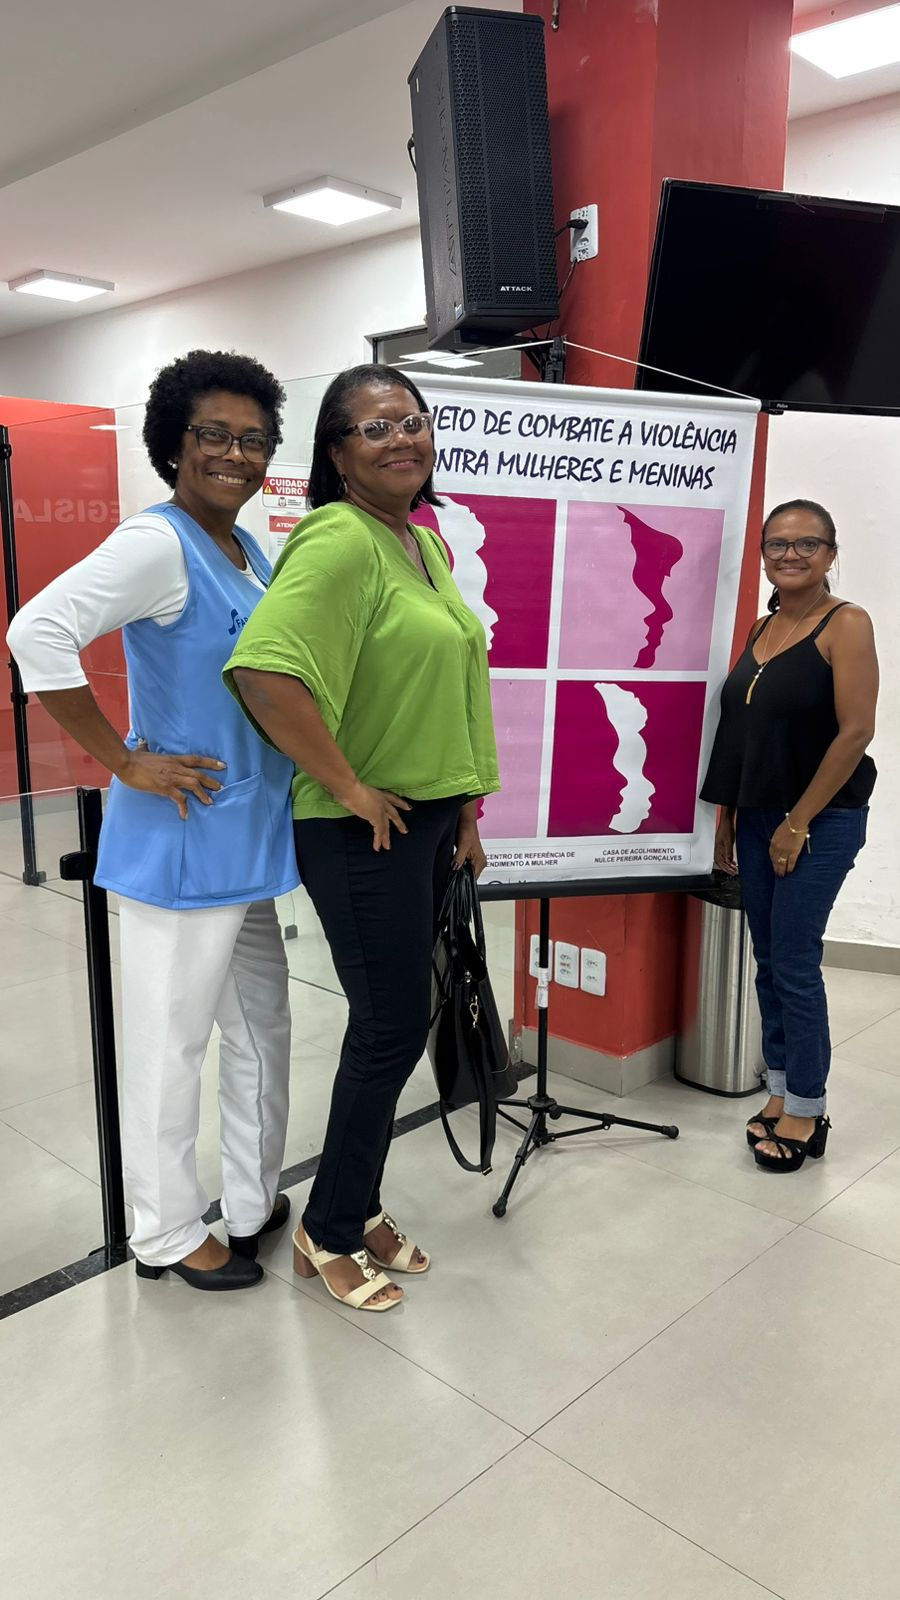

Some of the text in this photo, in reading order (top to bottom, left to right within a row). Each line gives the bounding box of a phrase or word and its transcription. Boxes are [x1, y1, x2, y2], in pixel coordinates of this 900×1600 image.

[483, 409, 512, 435] DE
[518, 413, 614, 442] COMBATE
[618, 420, 632, 446] A
[641, 421, 737, 454] VIOLÊNCIA
[497, 450, 604, 483] MULHERES
[609, 459, 623, 483] E
[628, 460, 715, 490] MENINAS
[269, 479, 309, 488] CUIDADO
[276, 487, 303, 495] VIDRO
[525, 851, 565, 859] REFERÊNCIA
